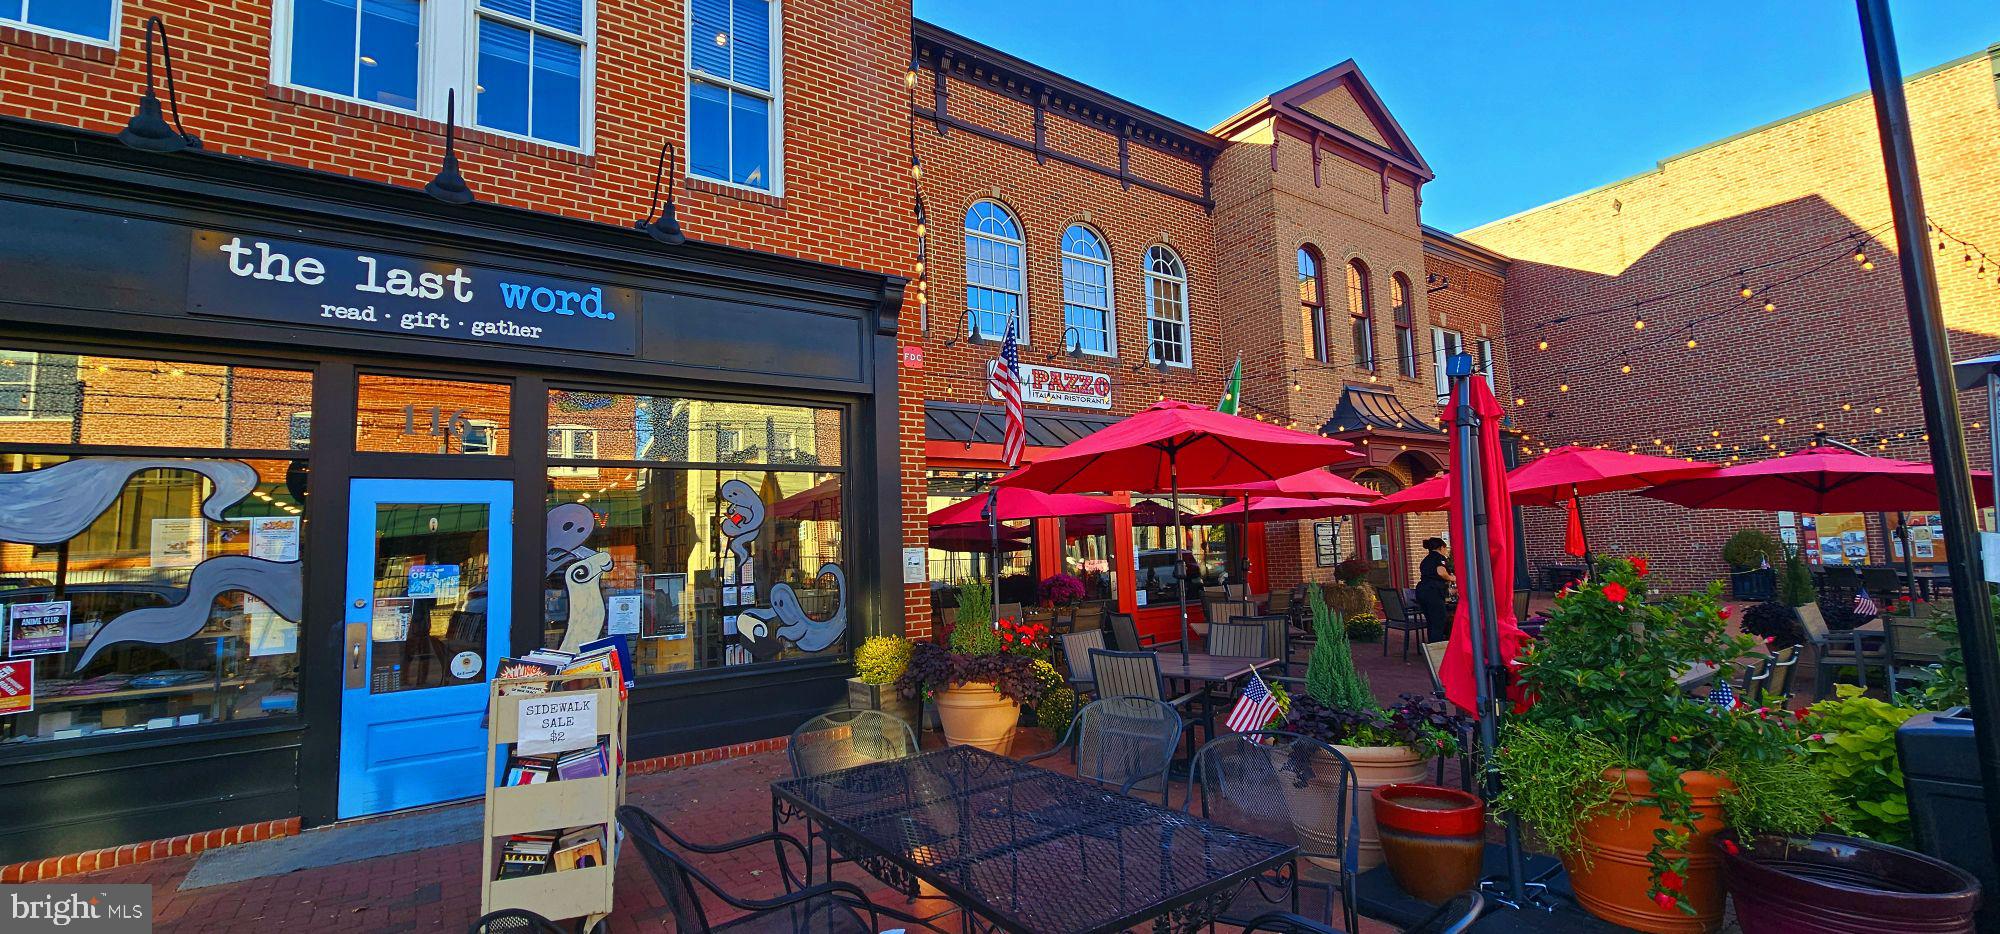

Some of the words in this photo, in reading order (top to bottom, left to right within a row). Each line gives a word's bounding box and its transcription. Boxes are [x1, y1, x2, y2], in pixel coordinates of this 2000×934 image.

[220, 237, 326, 285] the
[356, 255, 473, 303] last
[500, 281, 616, 320] word.
[320, 303, 377, 323] read
[400, 310, 450, 331] gift
[471, 318, 543, 339] gather
[904, 353, 922, 362] FDC
[1031, 368, 1111, 396] PAZZO
[1032, 391, 1062, 400] ITALAN
[400, 403, 473, 438] 116
[411, 571, 440, 579] OPEN
[21, 617, 42, 626] ANIME
[43, 616, 60, 625] CLUB
[526, 701, 591, 716] SIDEWALK
[541, 716, 575, 729] SALE
[549, 730, 566, 744] $2
